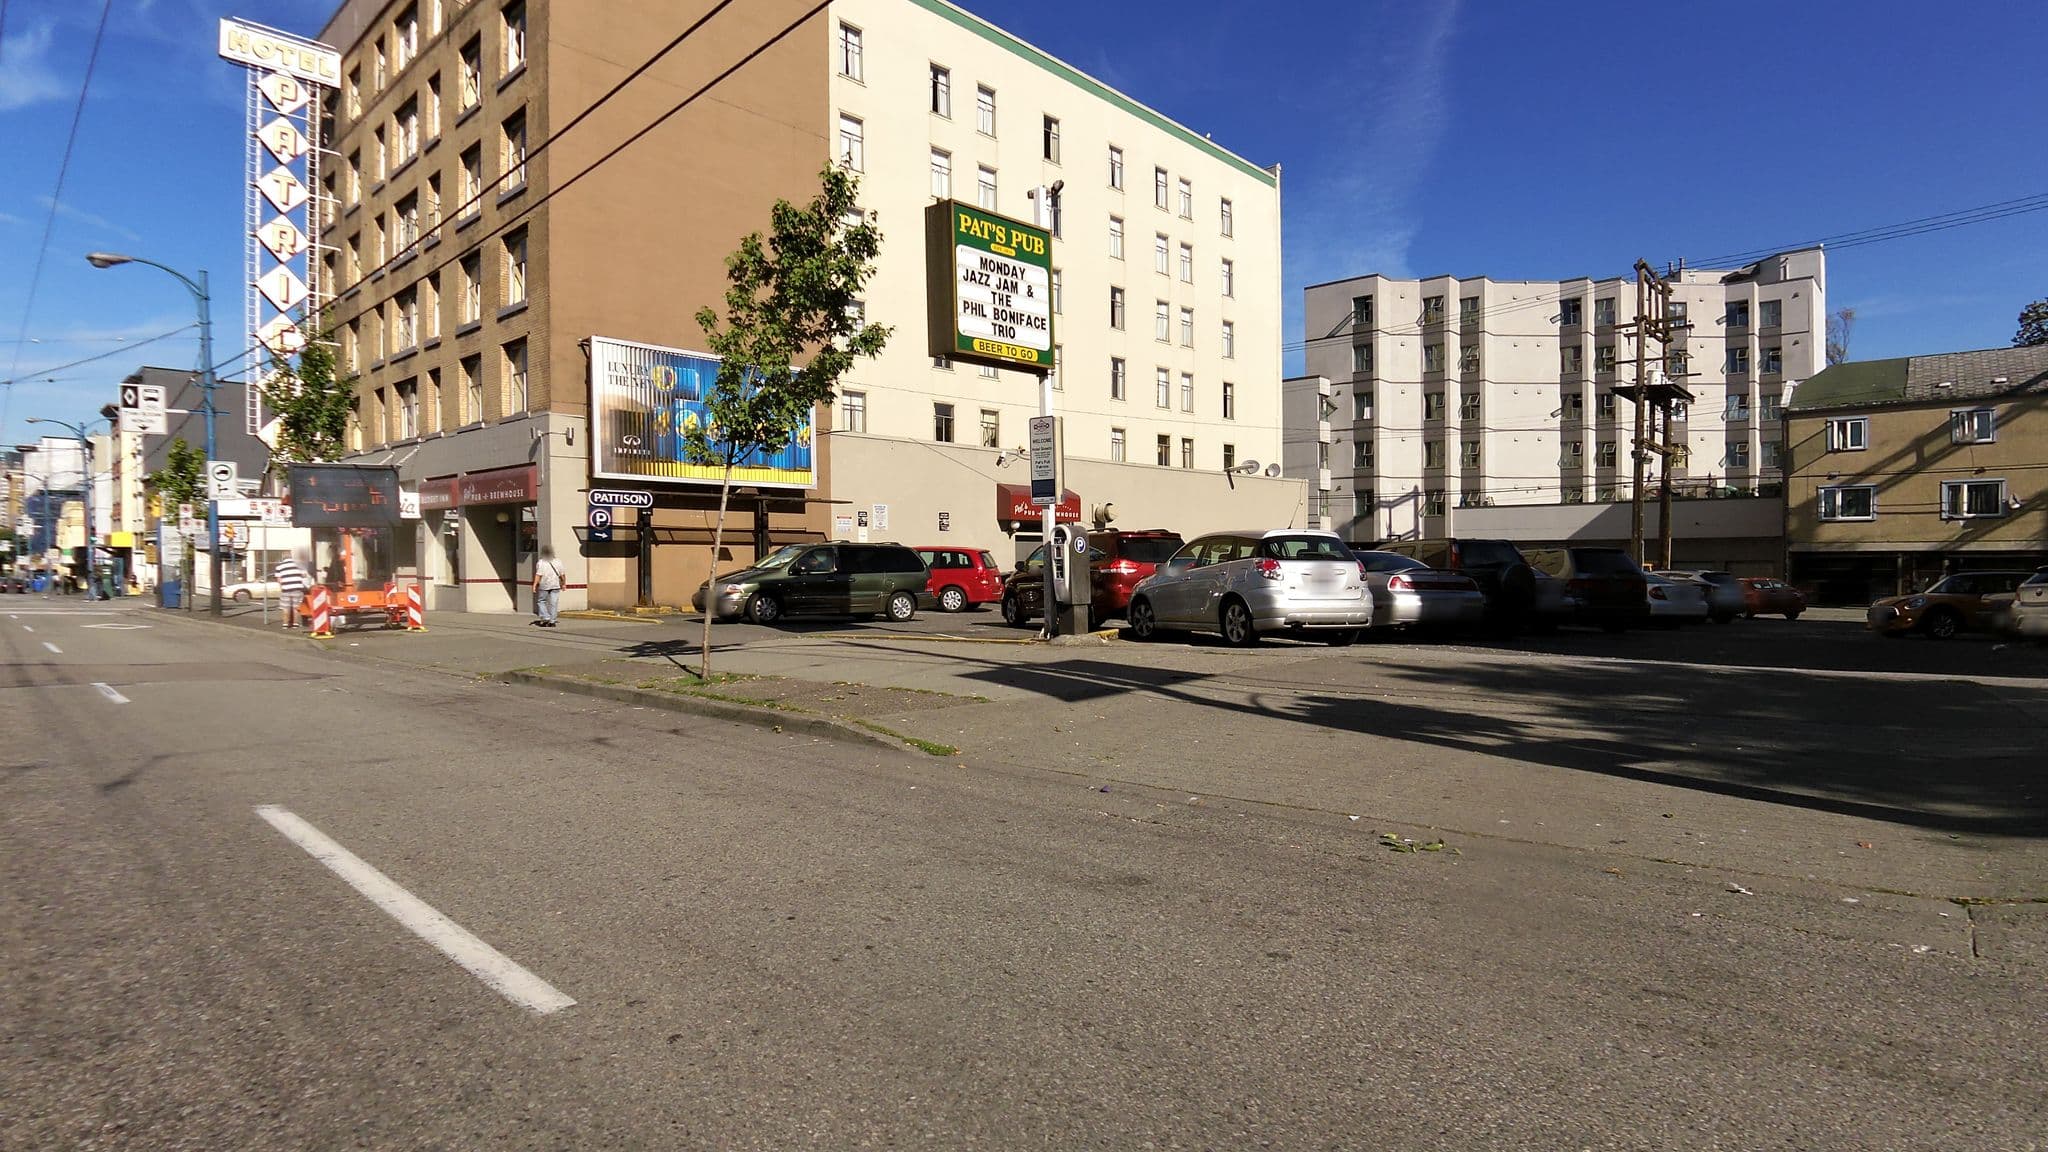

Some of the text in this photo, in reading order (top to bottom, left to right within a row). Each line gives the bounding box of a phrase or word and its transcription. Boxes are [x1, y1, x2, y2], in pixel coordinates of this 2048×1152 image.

[228, 29, 336, 79] HOTEL
[959, 213, 1044, 255] PAT'S PUB
[980, 256, 1026, 280] MONDAY
[963, 268, 1034, 298] JAZZ JAM &
[991, 291, 1012, 307] THE
[963, 300, 1047, 330] PHIL BONIFACE
[991, 322, 1016, 339] TRIO
[979, 341, 1033, 360] BEER TO GO
[594, 492, 648, 504] PATTISON
[596, 512, 607, 526] P
